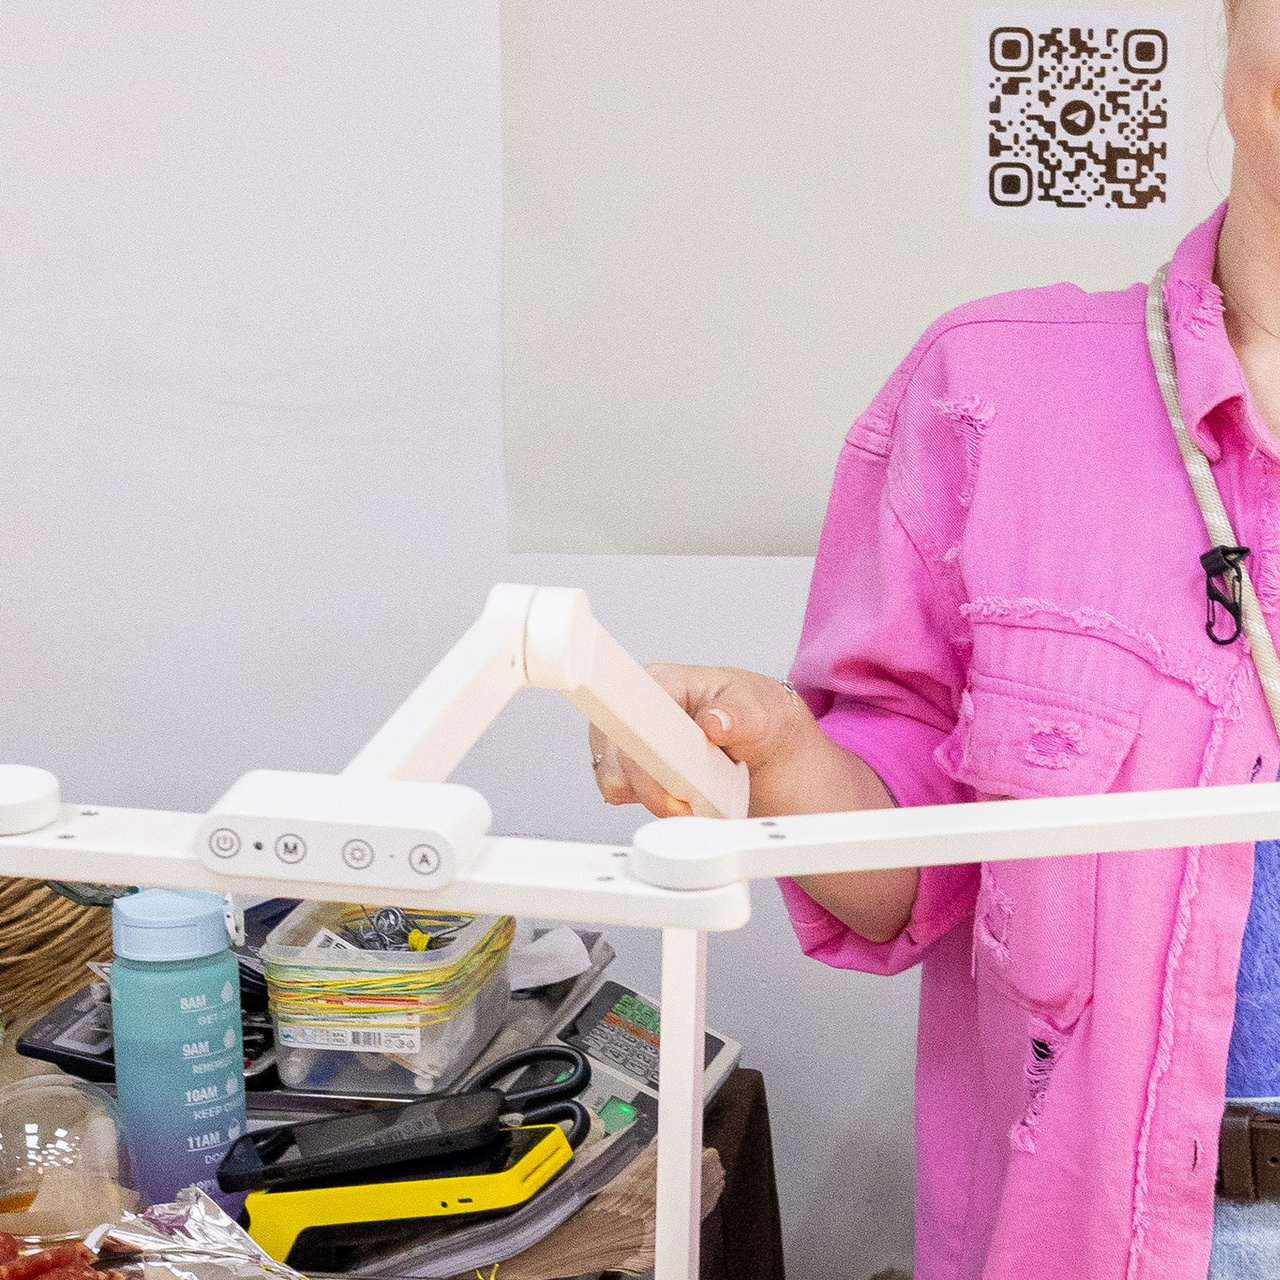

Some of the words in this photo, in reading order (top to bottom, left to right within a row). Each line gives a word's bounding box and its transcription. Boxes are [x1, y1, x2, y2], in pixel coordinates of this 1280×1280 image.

[181, 995, 206, 1011] 8AM
[183, 1040, 210, 1057] 9AM
[186, 1086, 218, 1103] 10AM
[194, 1105, 222, 1120] KEEP
[187, 1131, 221, 1149] 11AM
